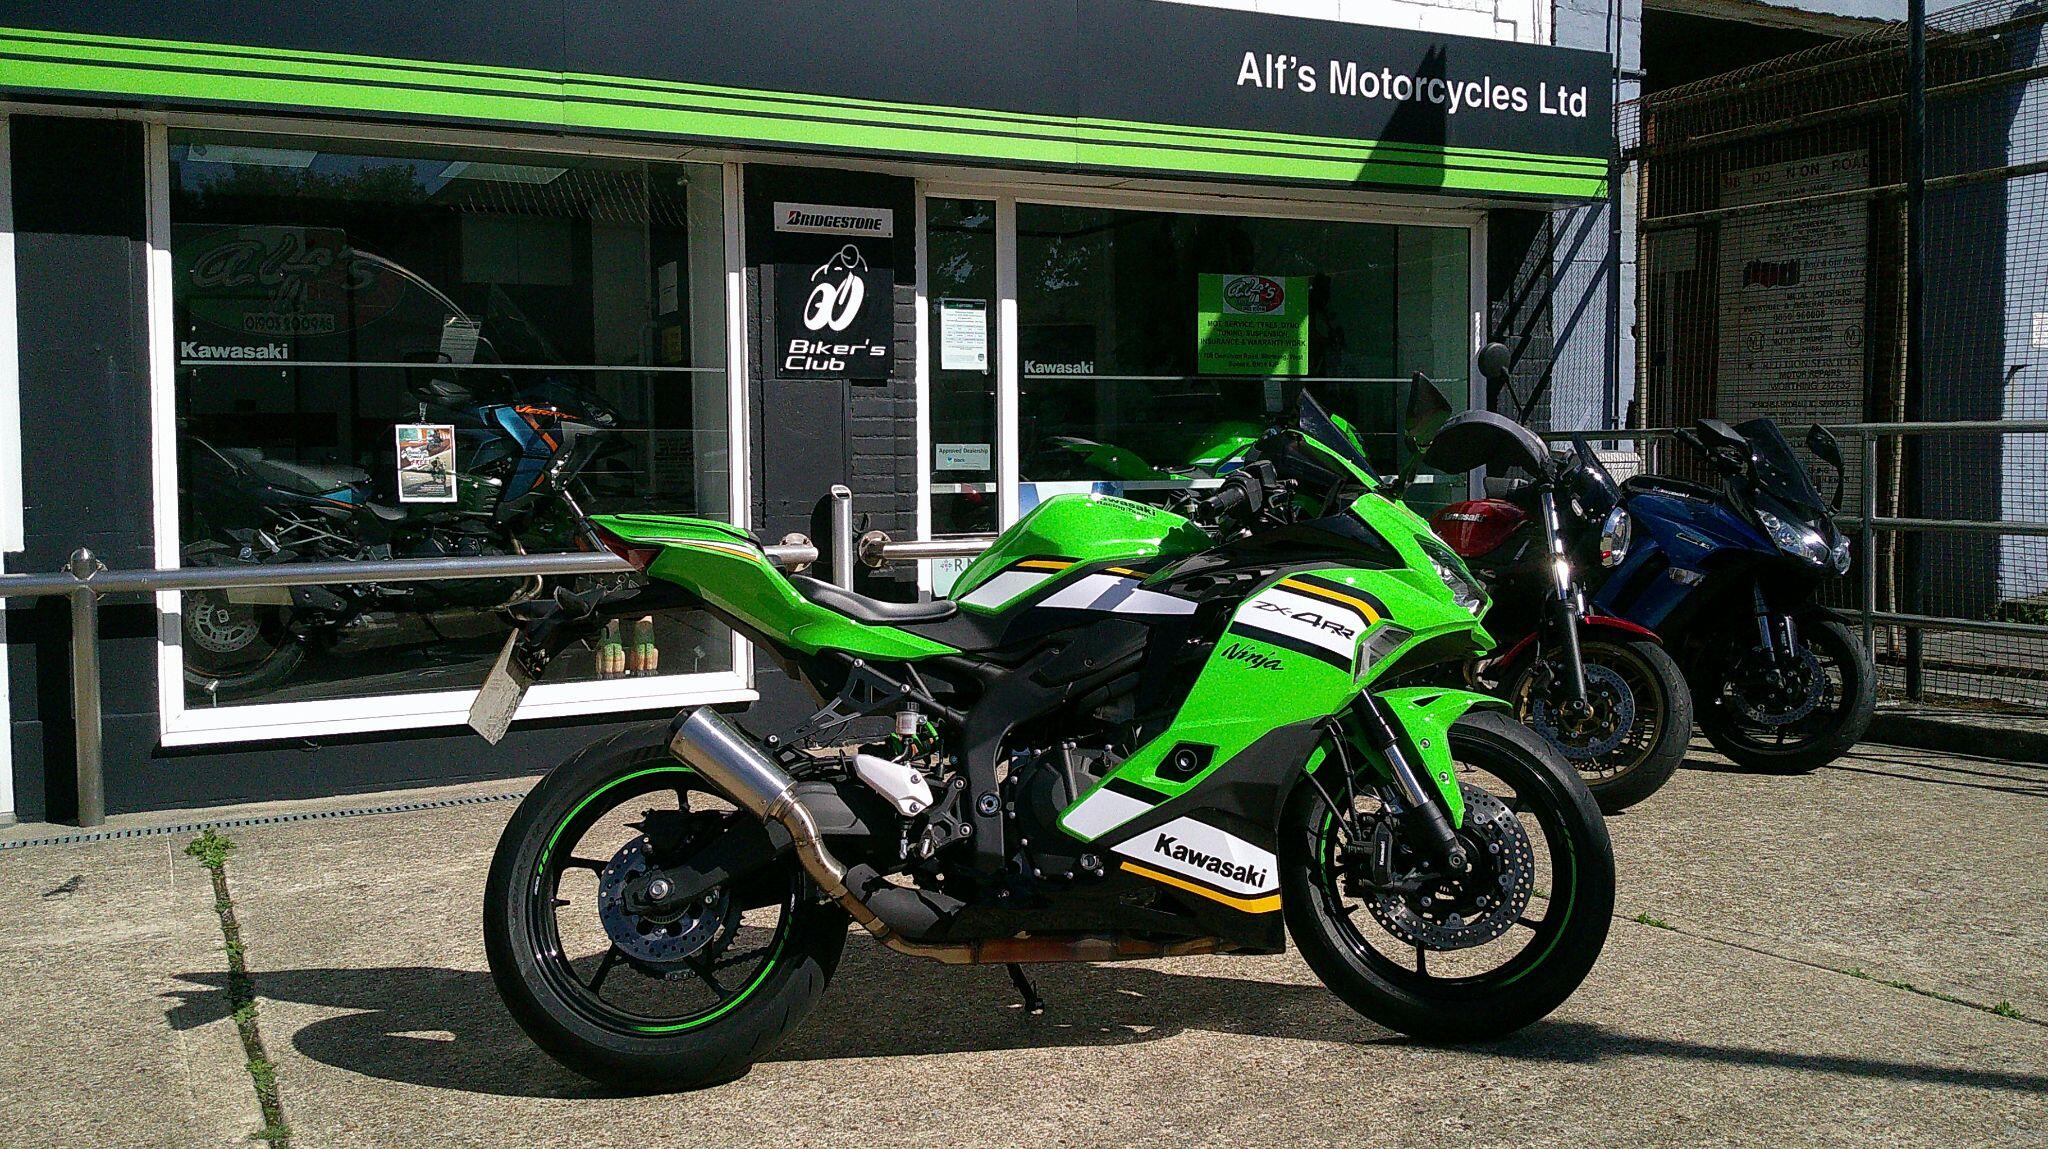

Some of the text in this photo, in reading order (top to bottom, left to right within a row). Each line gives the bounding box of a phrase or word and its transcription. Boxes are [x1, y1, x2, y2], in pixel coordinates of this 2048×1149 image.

[1237, 51, 1588, 118] Alf's Motorcycles Ltd
[787, 210, 882, 231] BRIDGESTONE
[181, 341, 288, 359] Kawasaki
[788, 338, 887, 356] Biker's
[785, 355, 846, 371] Club
[1024, 360, 1094, 374] Kawasaki
[938, 447, 989, 455] Approved Dealership
[1252, 600, 1356, 641] ZX-4RR
[1220, 642, 1285, 671] Ninja
[1154, 833, 1268, 888] Kawasaki
